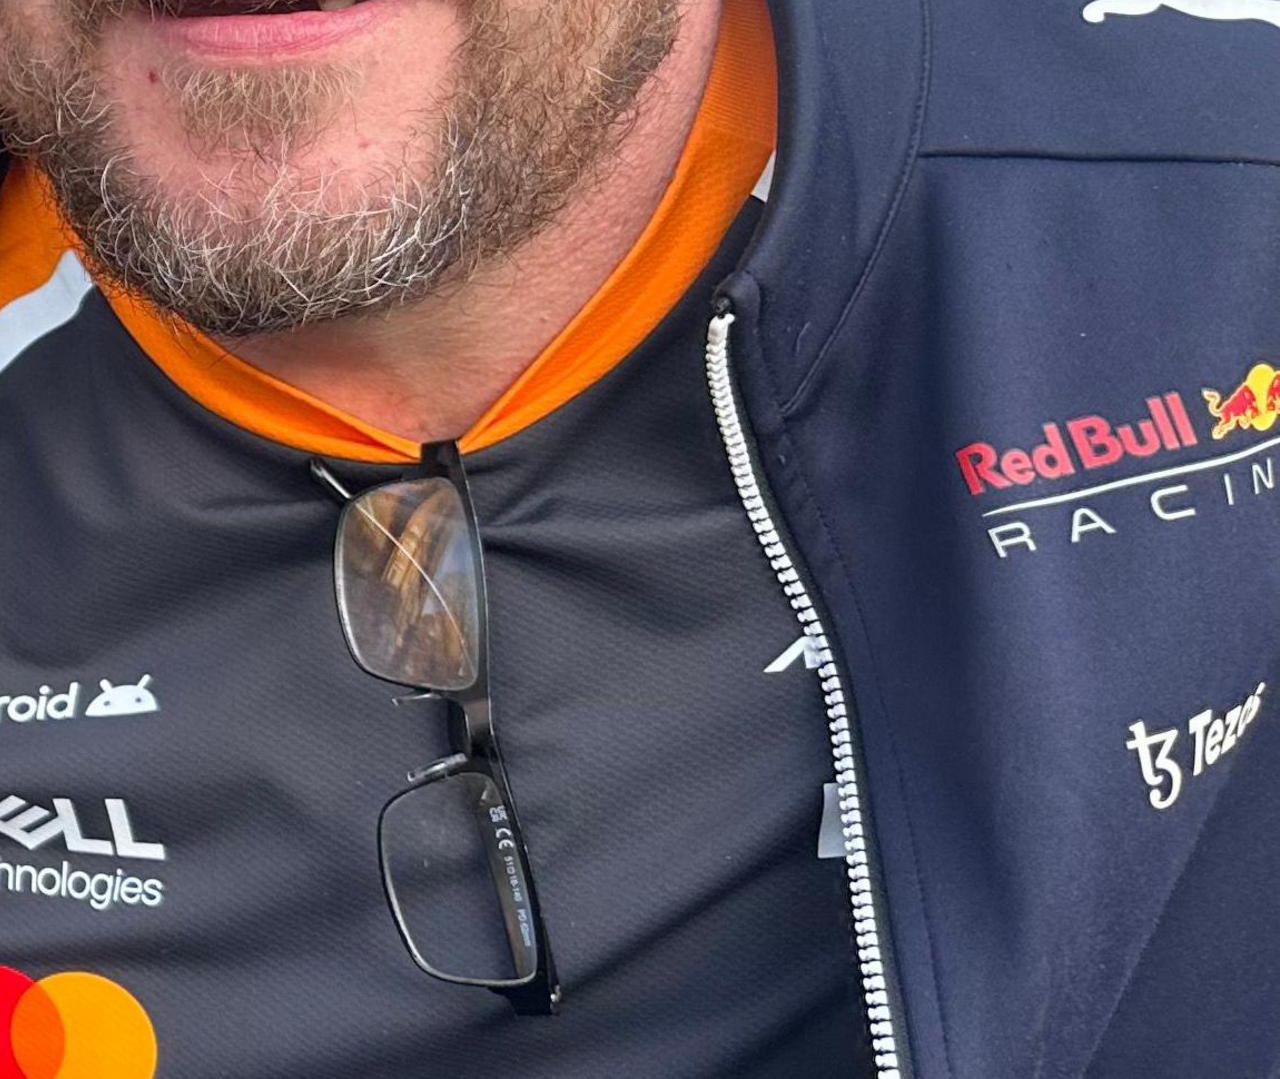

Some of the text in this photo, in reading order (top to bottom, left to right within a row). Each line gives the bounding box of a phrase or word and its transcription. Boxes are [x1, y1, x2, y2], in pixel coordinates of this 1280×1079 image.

[954, 391, 1199, 496] Red Bull
[987, 456, 1275, 559] RACIN
[496, 827, 515, 850] CE
